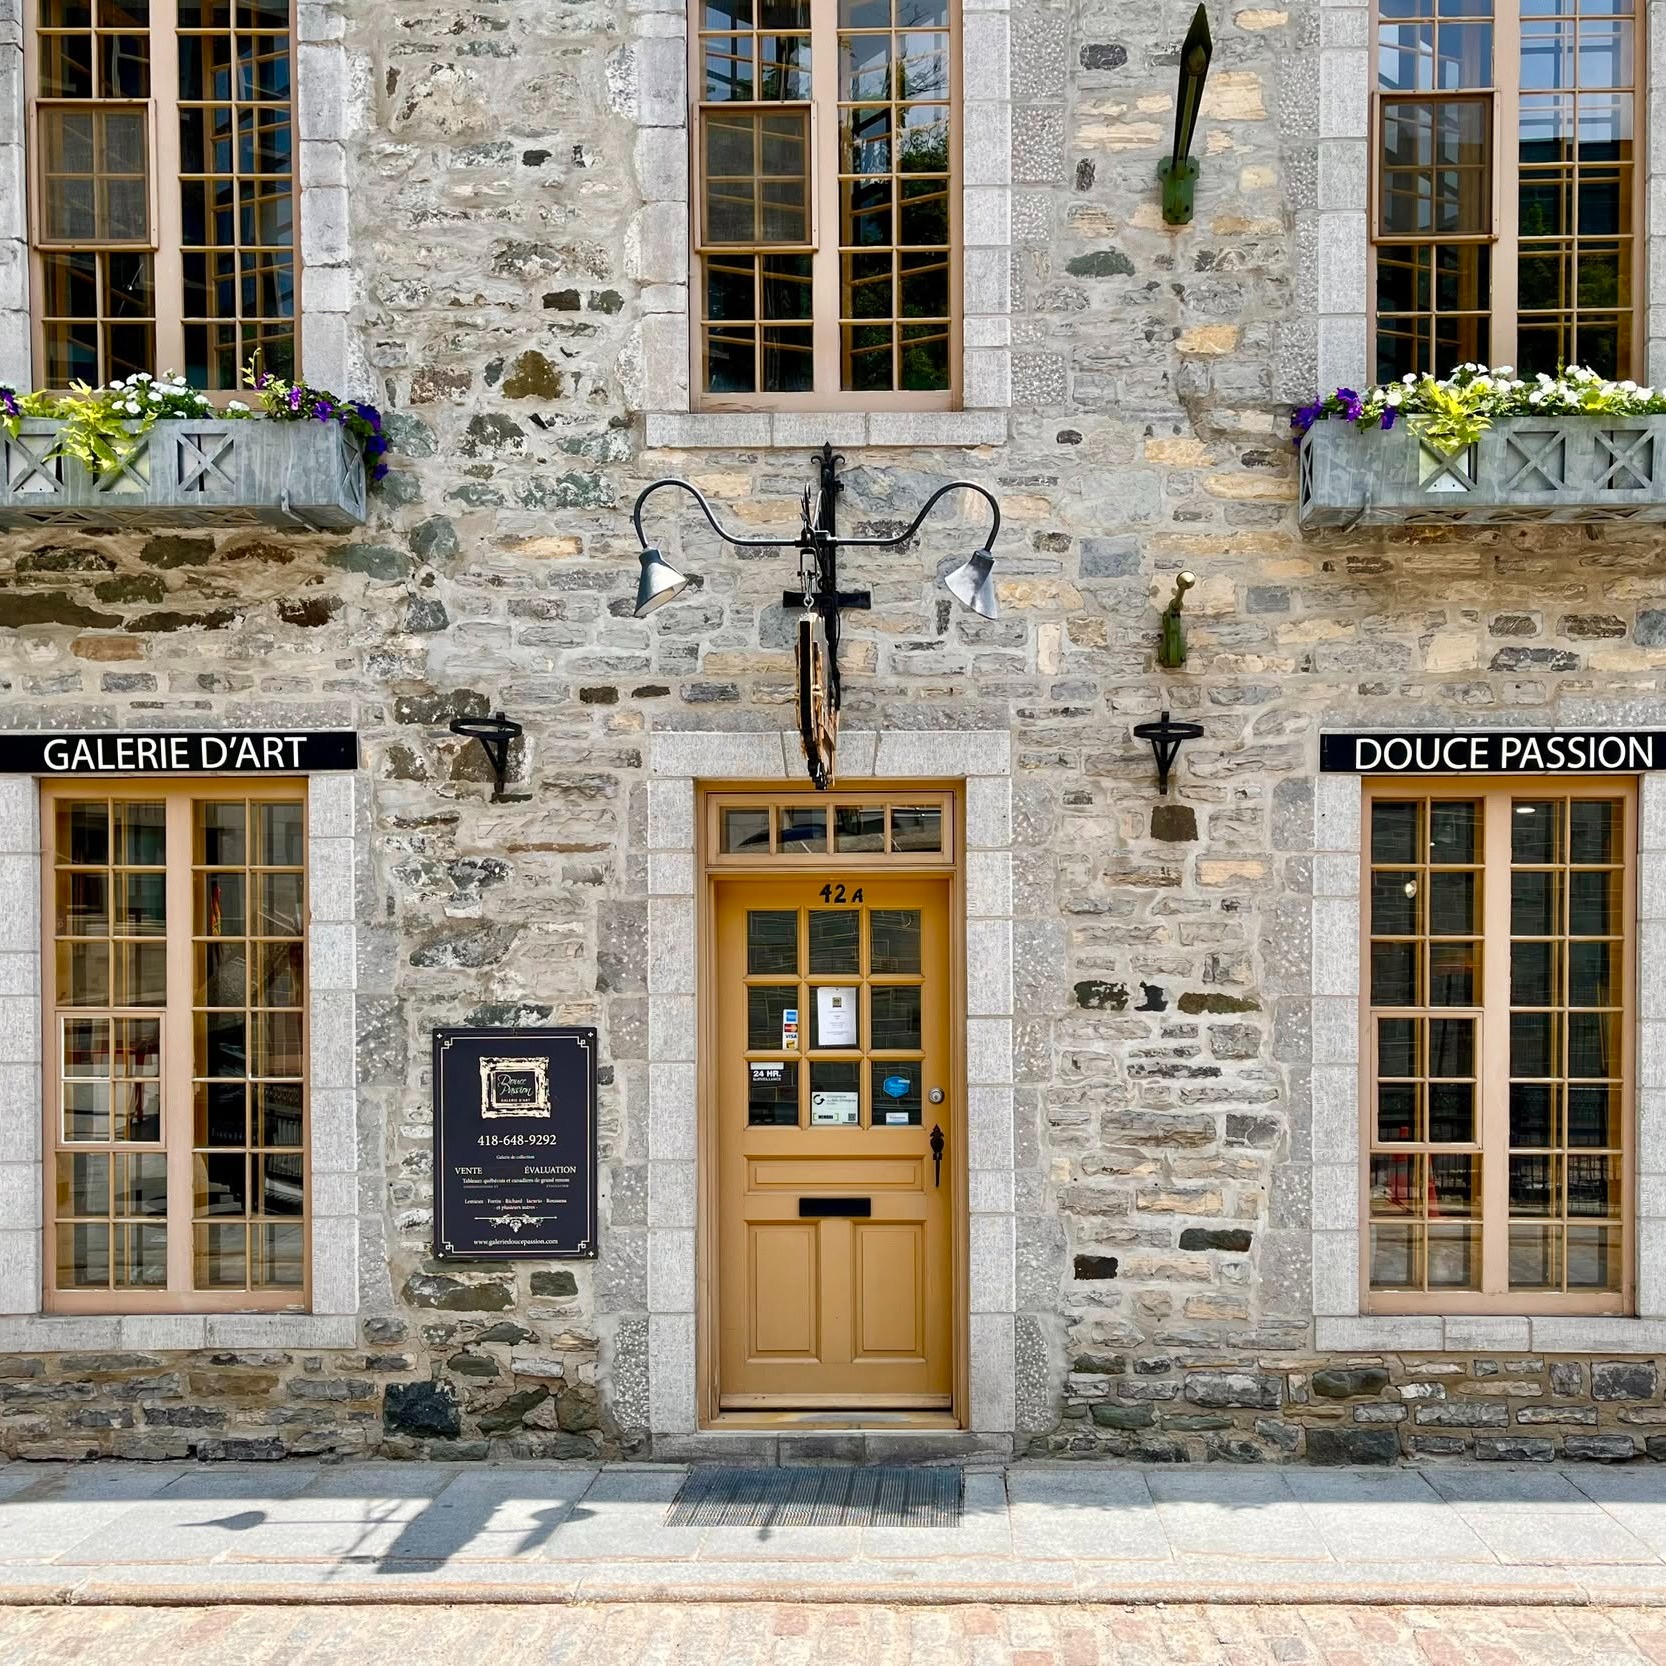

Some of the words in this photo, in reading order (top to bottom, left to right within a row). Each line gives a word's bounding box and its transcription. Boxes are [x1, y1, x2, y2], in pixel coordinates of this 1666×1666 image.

[43, 737, 190, 770] GALERIE
[201, 736, 307, 769] D'ART
[1355, 737, 1489, 770] DOUCE
[1501, 736, 1653, 769] PASSION
[477, 1134, 557, 1147] 418-648-9292
[454, 1167, 483, 1175] VENTE
[524, 1165, 577, 1174] ÉVALUATION
[473, 1238, 559, 1247] www.galeriedoucepassion.com
